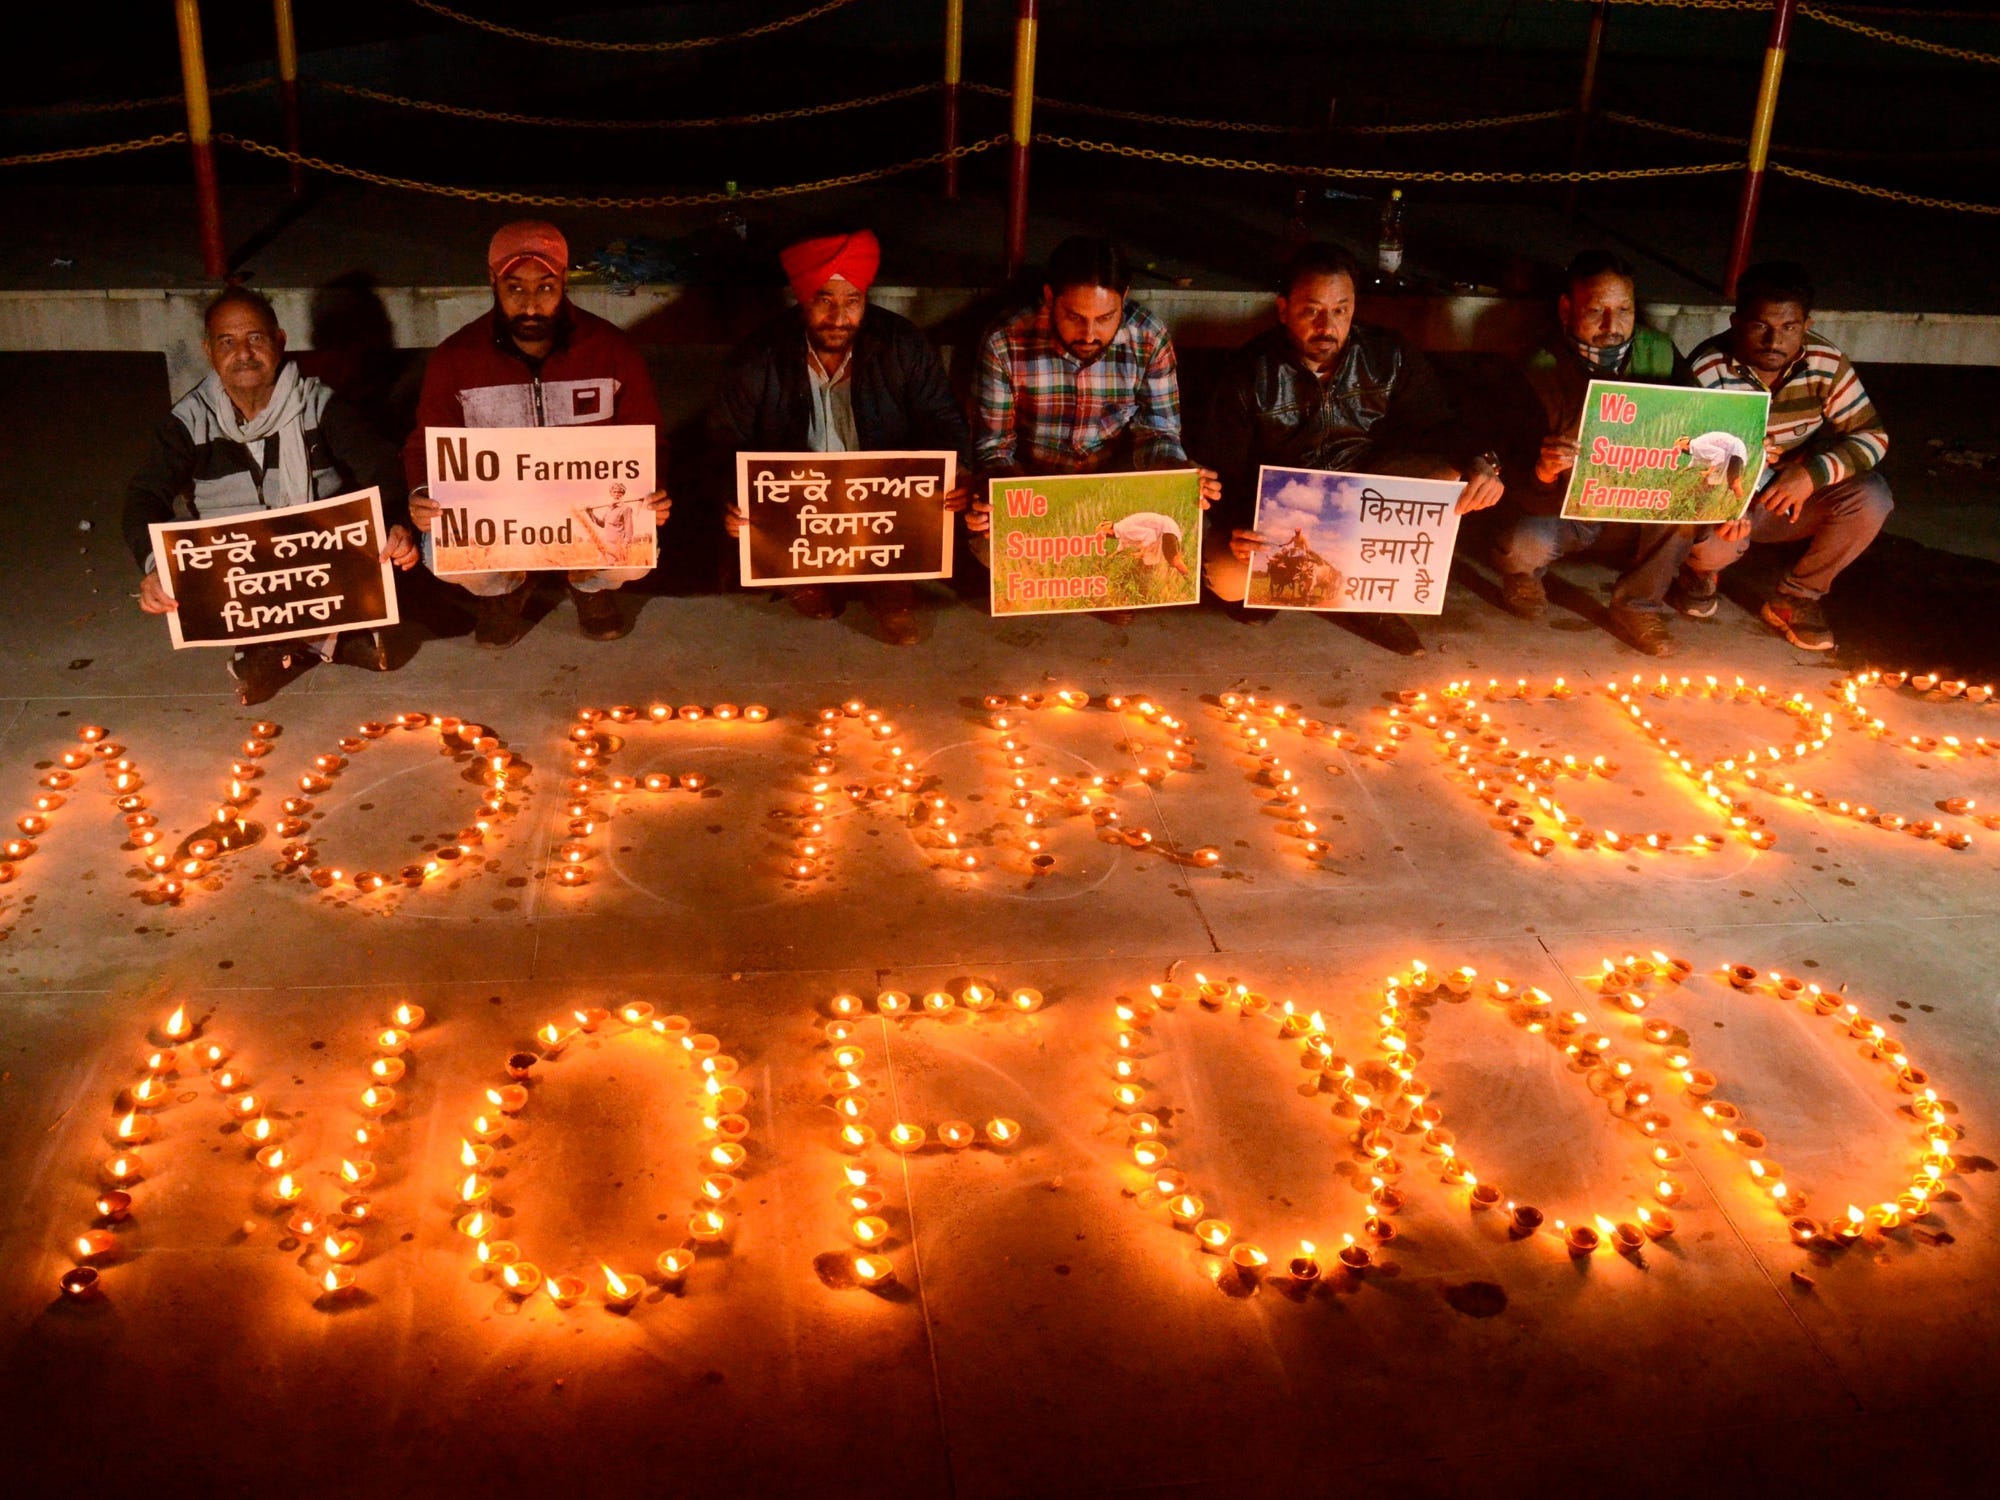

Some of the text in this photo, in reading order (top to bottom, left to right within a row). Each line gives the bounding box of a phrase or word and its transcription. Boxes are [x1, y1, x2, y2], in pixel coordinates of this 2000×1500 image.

[1600, 392, 1637, 424] We
[437, 437, 640, 482] No Farmers
[1590, 436, 1681, 473] Support
[753, 469, 939, 503] ਇੱਕੋ ਨਾਅਰ
[1005, 488, 1048, 518] We
[1580, 479, 1671, 509] Farmers
[797, 505, 897, 535] ਕਿਸਾਨ
[1360, 488, 1449, 527] किसान
[441, 508, 572, 548] No Food
[172, 520, 369, 571] ਇੱਕੋ ਨਾਅਰ
[789, 538, 904, 569] ਪਿਆਰਾ
[1007, 531, 1106, 565] Support
[1360, 532, 1433, 566] हमारी
[224, 563, 331, 598] ਕਿਸਾਨ
[1008, 572, 1108, 601] Farmers
[1344, 568, 1434, 604] शान है
[220, 595, 344, 632] ਪਿਆਰਾ
[60, 951, 1962, 1308] NO FOOD
